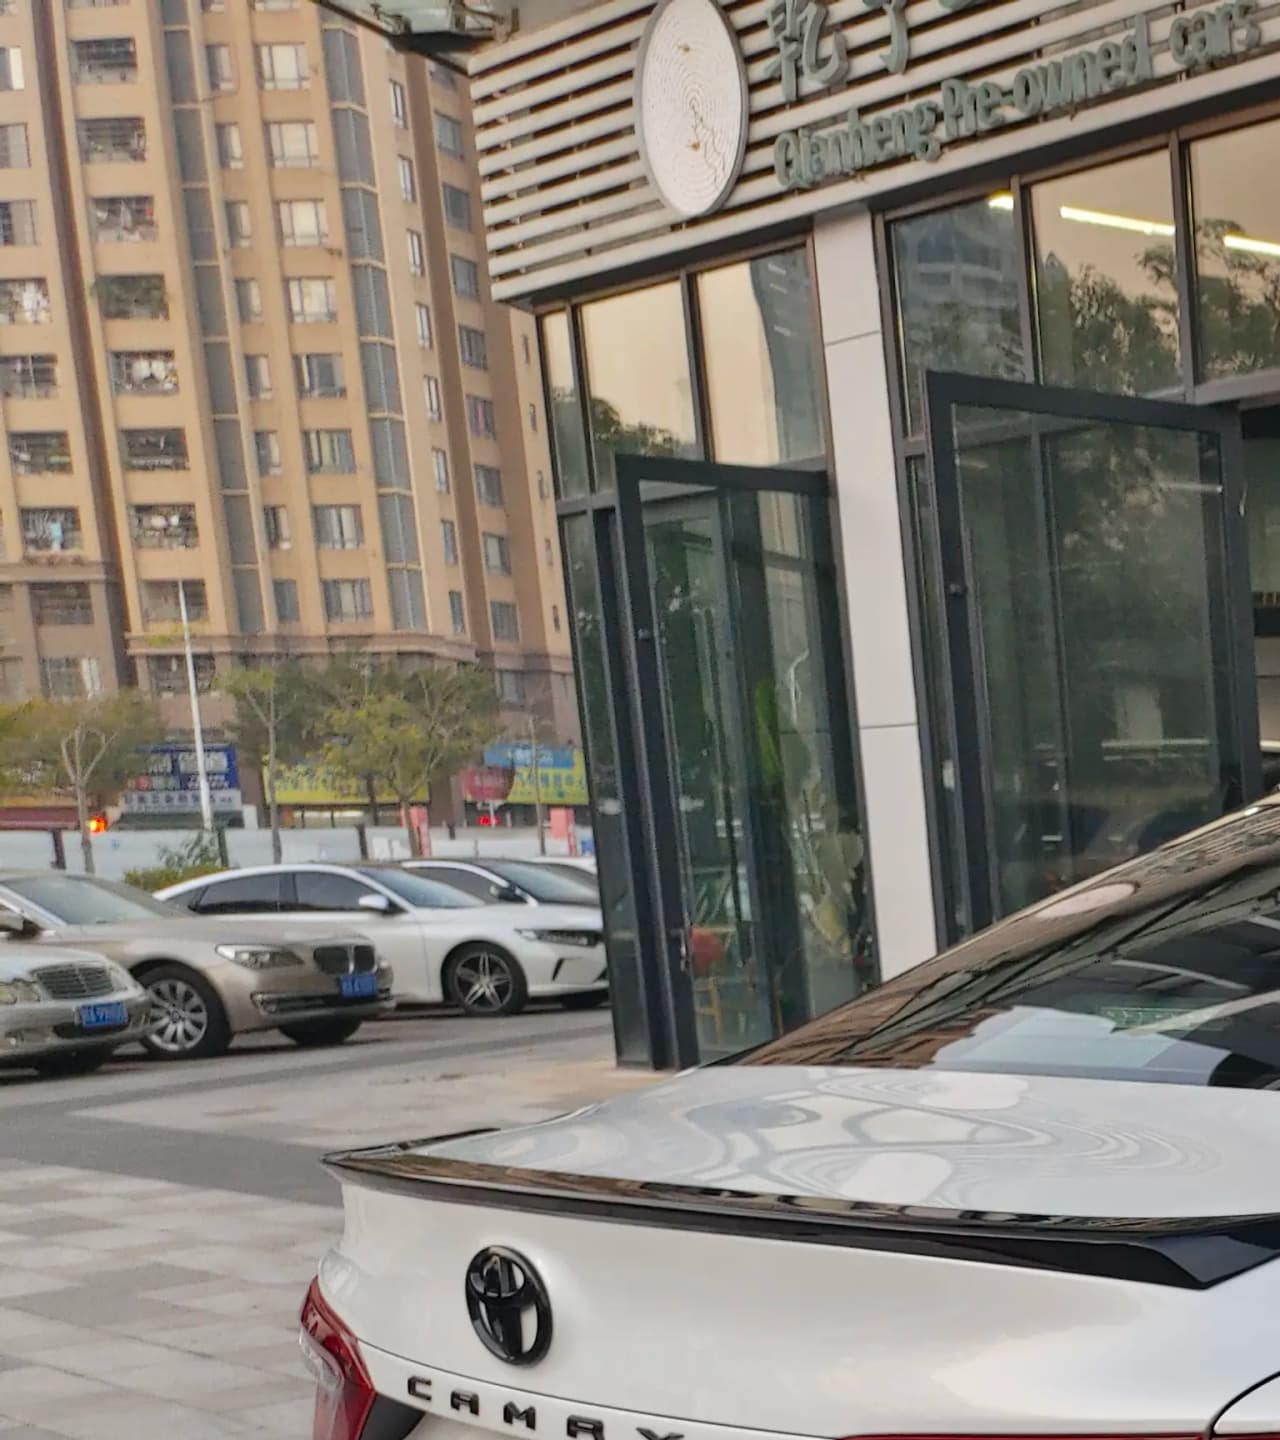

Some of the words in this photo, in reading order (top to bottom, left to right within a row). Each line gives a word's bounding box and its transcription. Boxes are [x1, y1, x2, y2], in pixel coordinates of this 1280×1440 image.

[774, 103, 944, 189] Qianheng
[941, 14, 1153, 138] Pre-owned
[1168, 0, 1263, 68] cars
